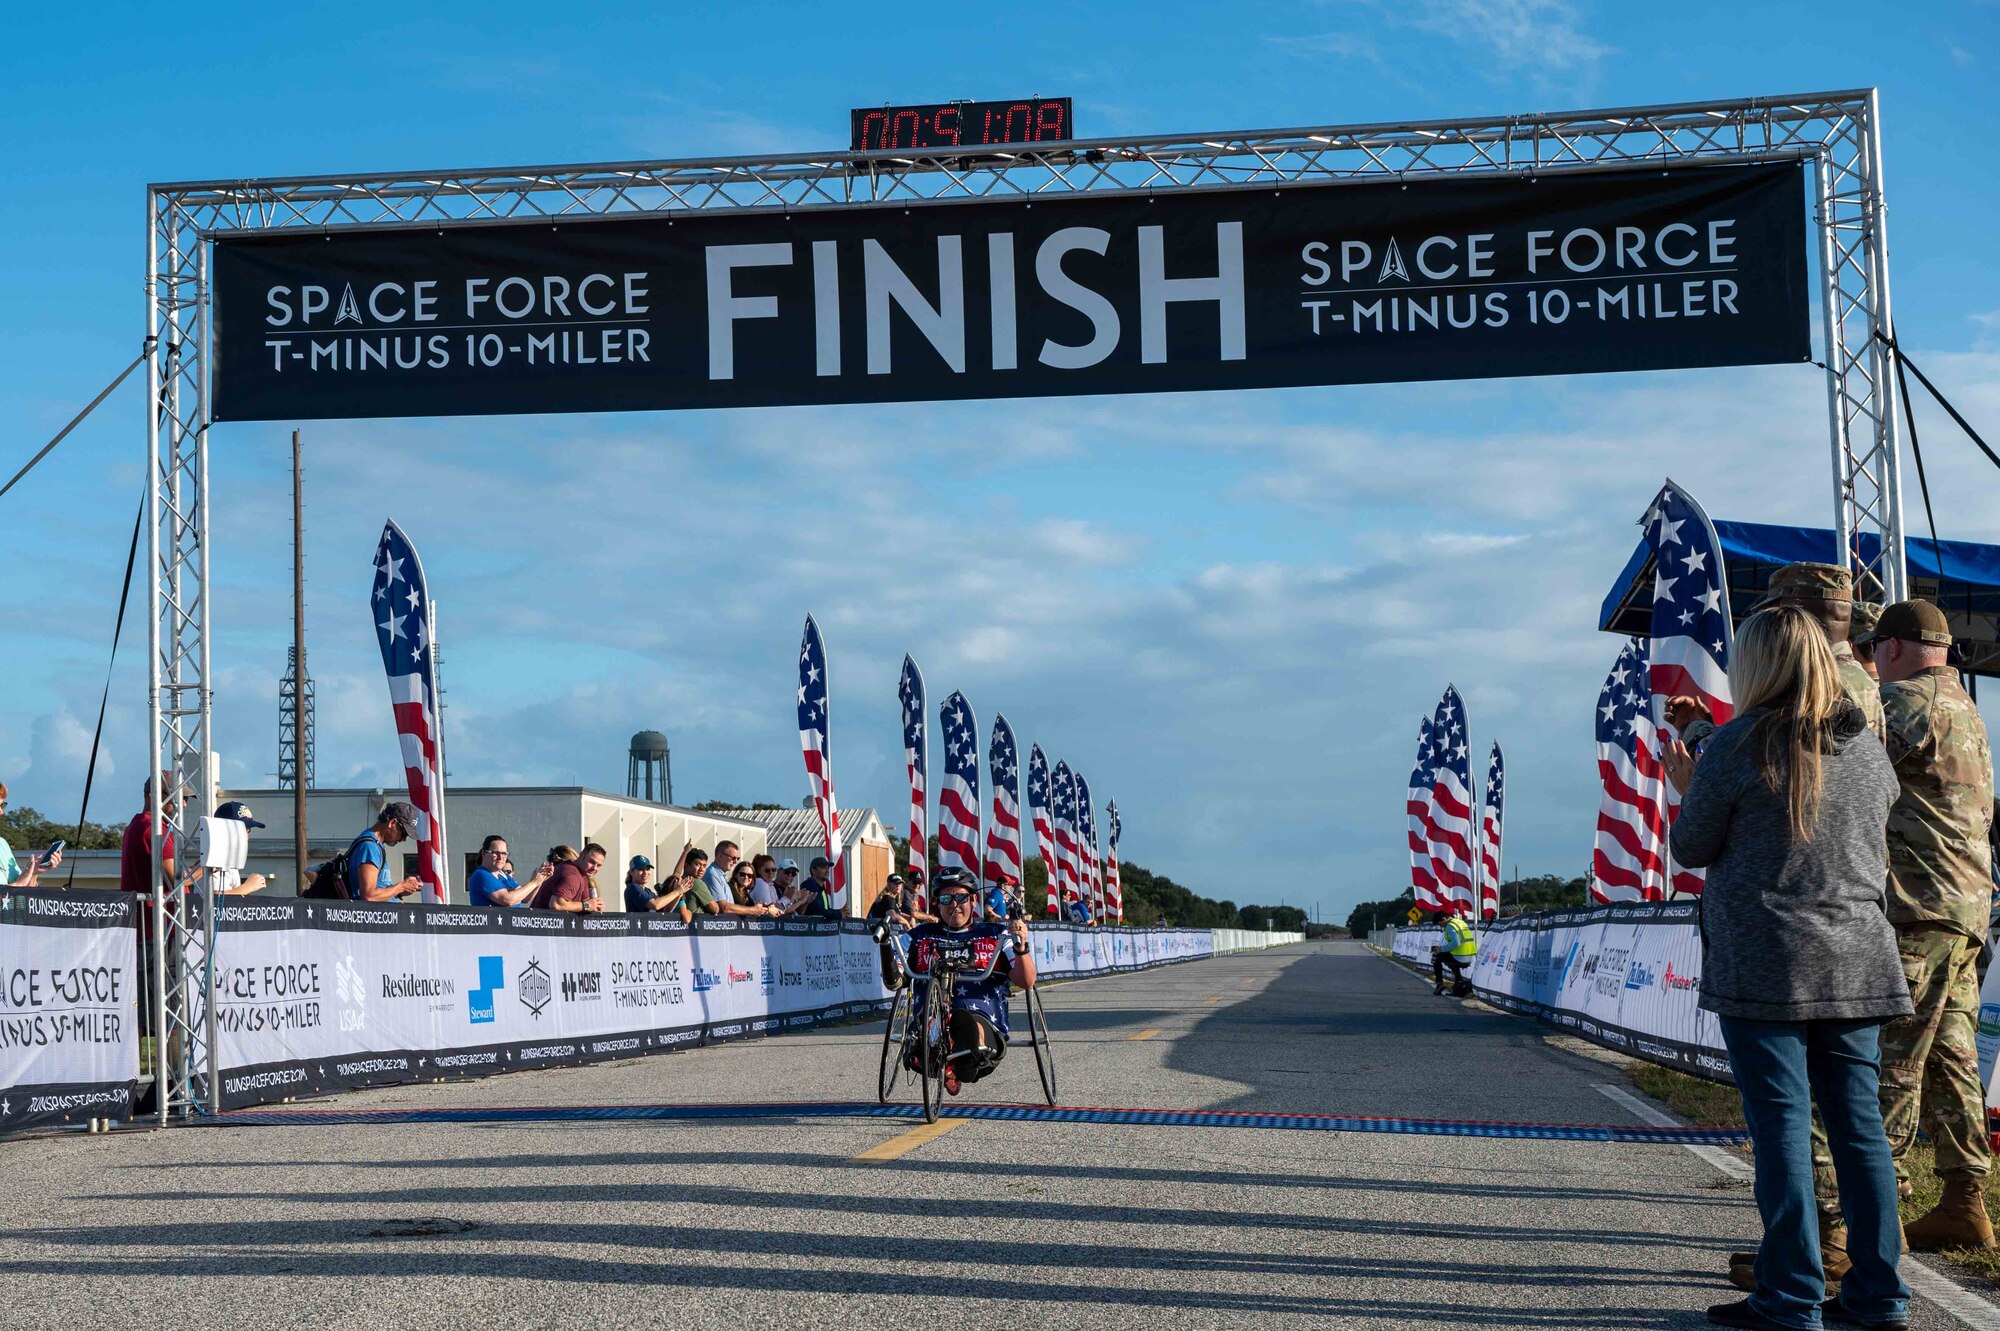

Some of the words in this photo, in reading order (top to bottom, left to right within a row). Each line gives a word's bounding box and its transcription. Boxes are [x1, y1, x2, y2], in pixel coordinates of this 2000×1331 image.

[1301, 233, 1496, 286] SPACE
[1527, 219, 1738, 275] FORCE
[265, 280, 438, 326] SPACE
[466, 272, 650, 319] FORCE
[705, 221, 1247, 380] FINISH
[1301, 291, 1509, 336] T-MINUS
[1527, 279, 1740, 325] 10-MILER
[265, 334, 450, 373] T-MINUS
[466, 328, 651, 368] 10-MILER
[28, 897, 129, 917] RUNSPACEFORCE.COM
[326, 908, 399, 924] RUNSPACEFORCE.COM
[426, 912, 488, 926] RUNSPACEFORCE.COM
[512, 916, 564, 929] RUNSPACEFORCE.COM
[583, 919, 630, 930] RUNSPACEFORCE.COM
[976, 942, 994, 950] The
[264, 963, 320, 997] FORCE
[578, 972, 601, 994] HOIST
[612, 961, 643, 984] SPACE
[647, 960, 680, 982] FORCE
[51, 966, 121, 1003] FORCE
[382, 973, 441, 998] Residence
[614, 988, 647, 1008] T-MINUS
[649, 987, 684, 1006] 10-MILER
[267, 1002, 321, 1031] 10-MILER
[339, 1009, 365, 1031] USAA
[0, 1016, 48, 1050] INUS
[592, 1037, 640, 1053] RUNSPACEFORCE.COM
